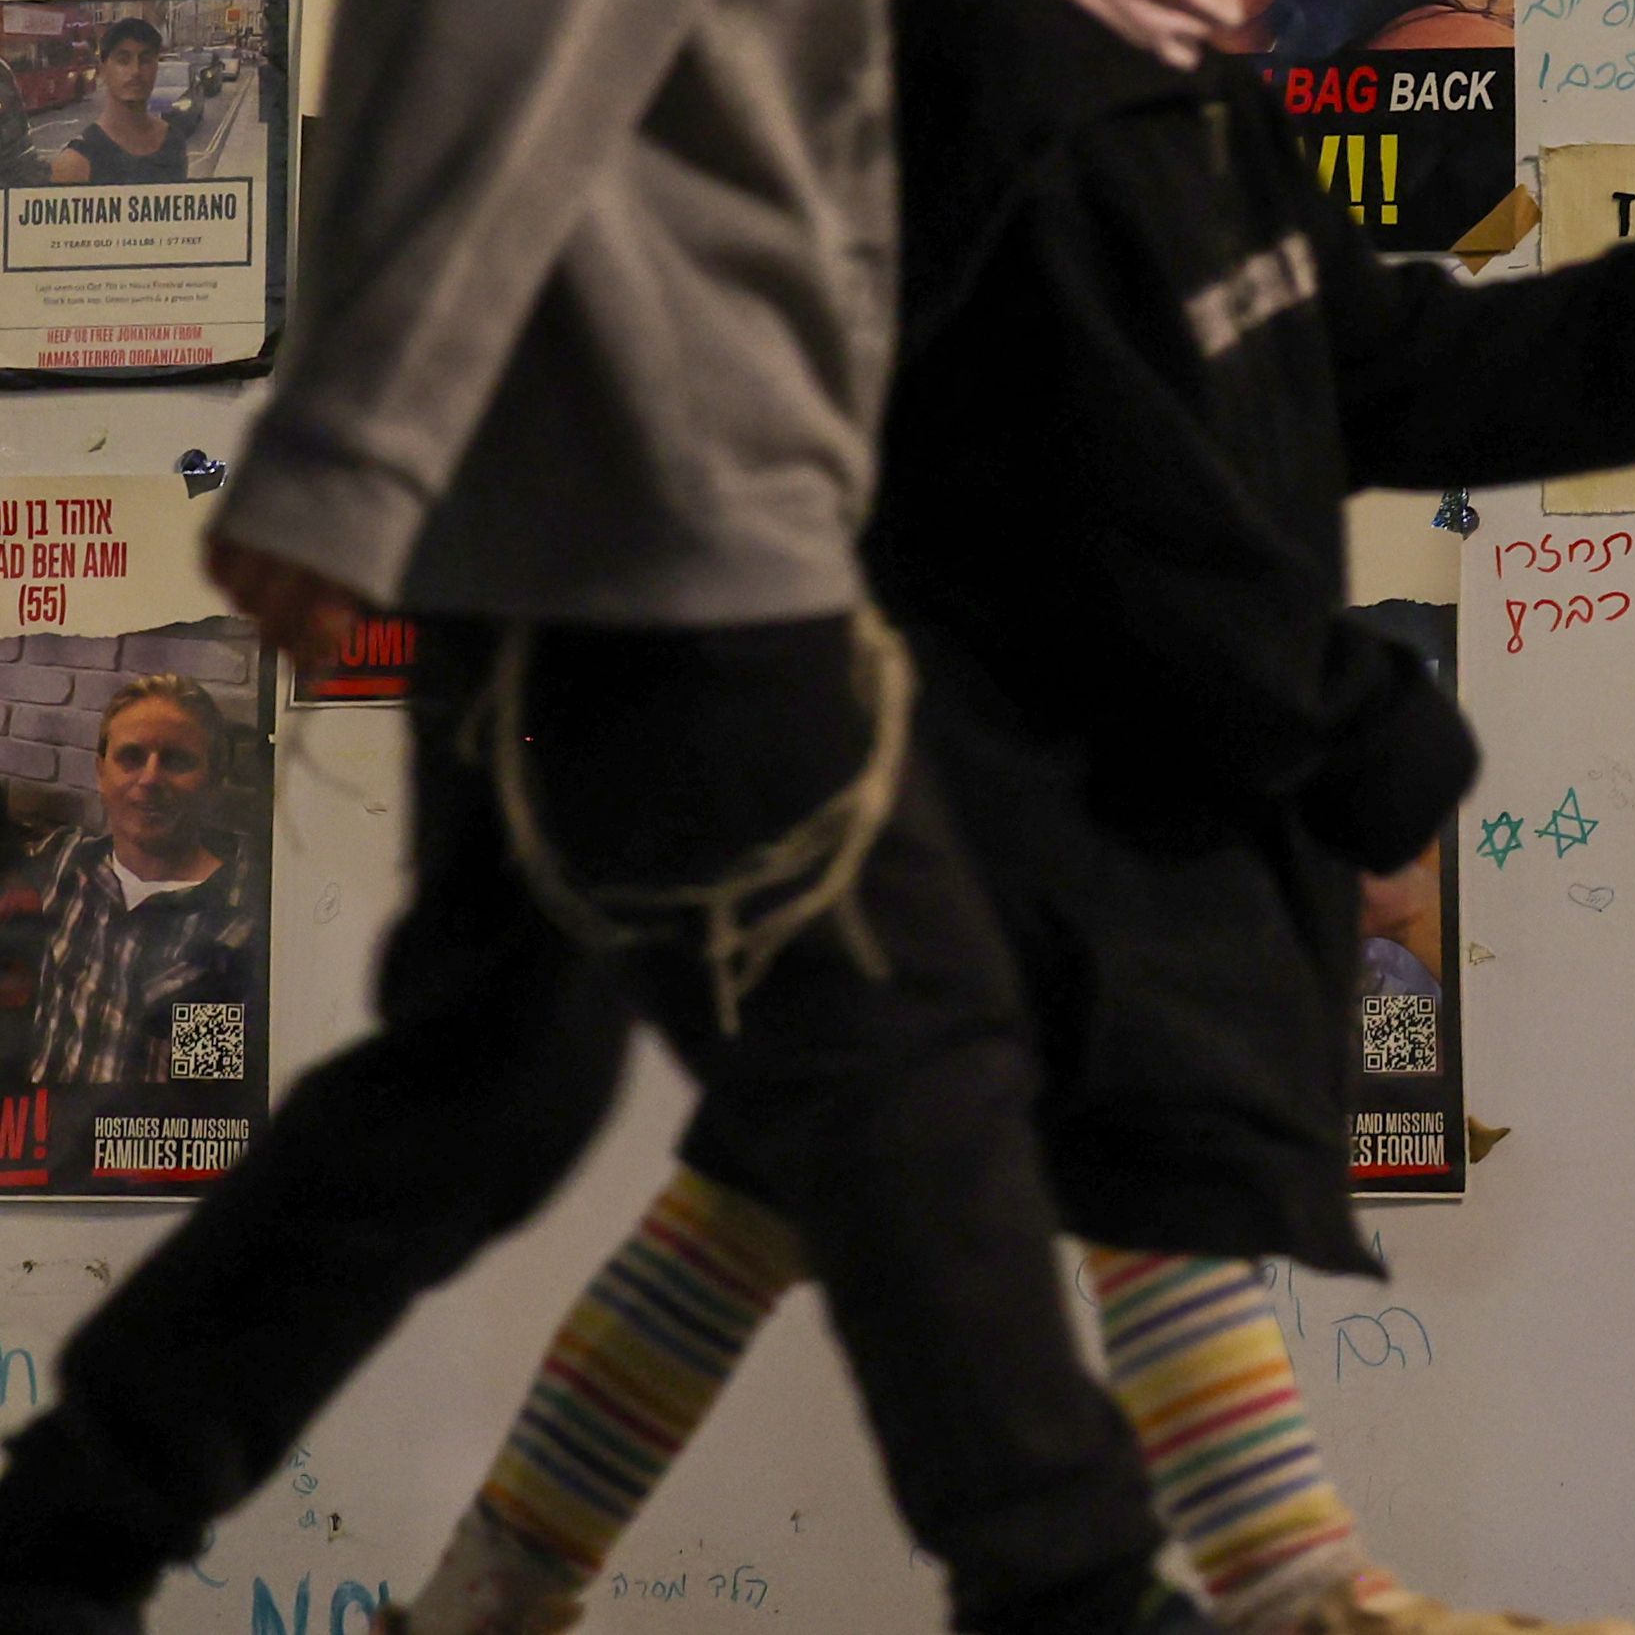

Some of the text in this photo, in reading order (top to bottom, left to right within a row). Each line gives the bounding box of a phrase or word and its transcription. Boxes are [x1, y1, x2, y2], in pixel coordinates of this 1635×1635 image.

[1285, 66, 1496, 115] BAG BACK
[19, 193, 237, 225] JONATHAN SAMERANO
[47, 328, 71, 344] HELP
[90, 327, 113, 342] FREE
[117, 326, 170, 342] JONATHAN
[173, 325, 203, 340] FROM
[38, 348, 213, 368] HAMAS TERROR ORGANIZATION
[26, 499, 112, 538] אוהד בן
[33, 542, 126, 578] BEN AMI
[19, 585, 66, 624] (55)
